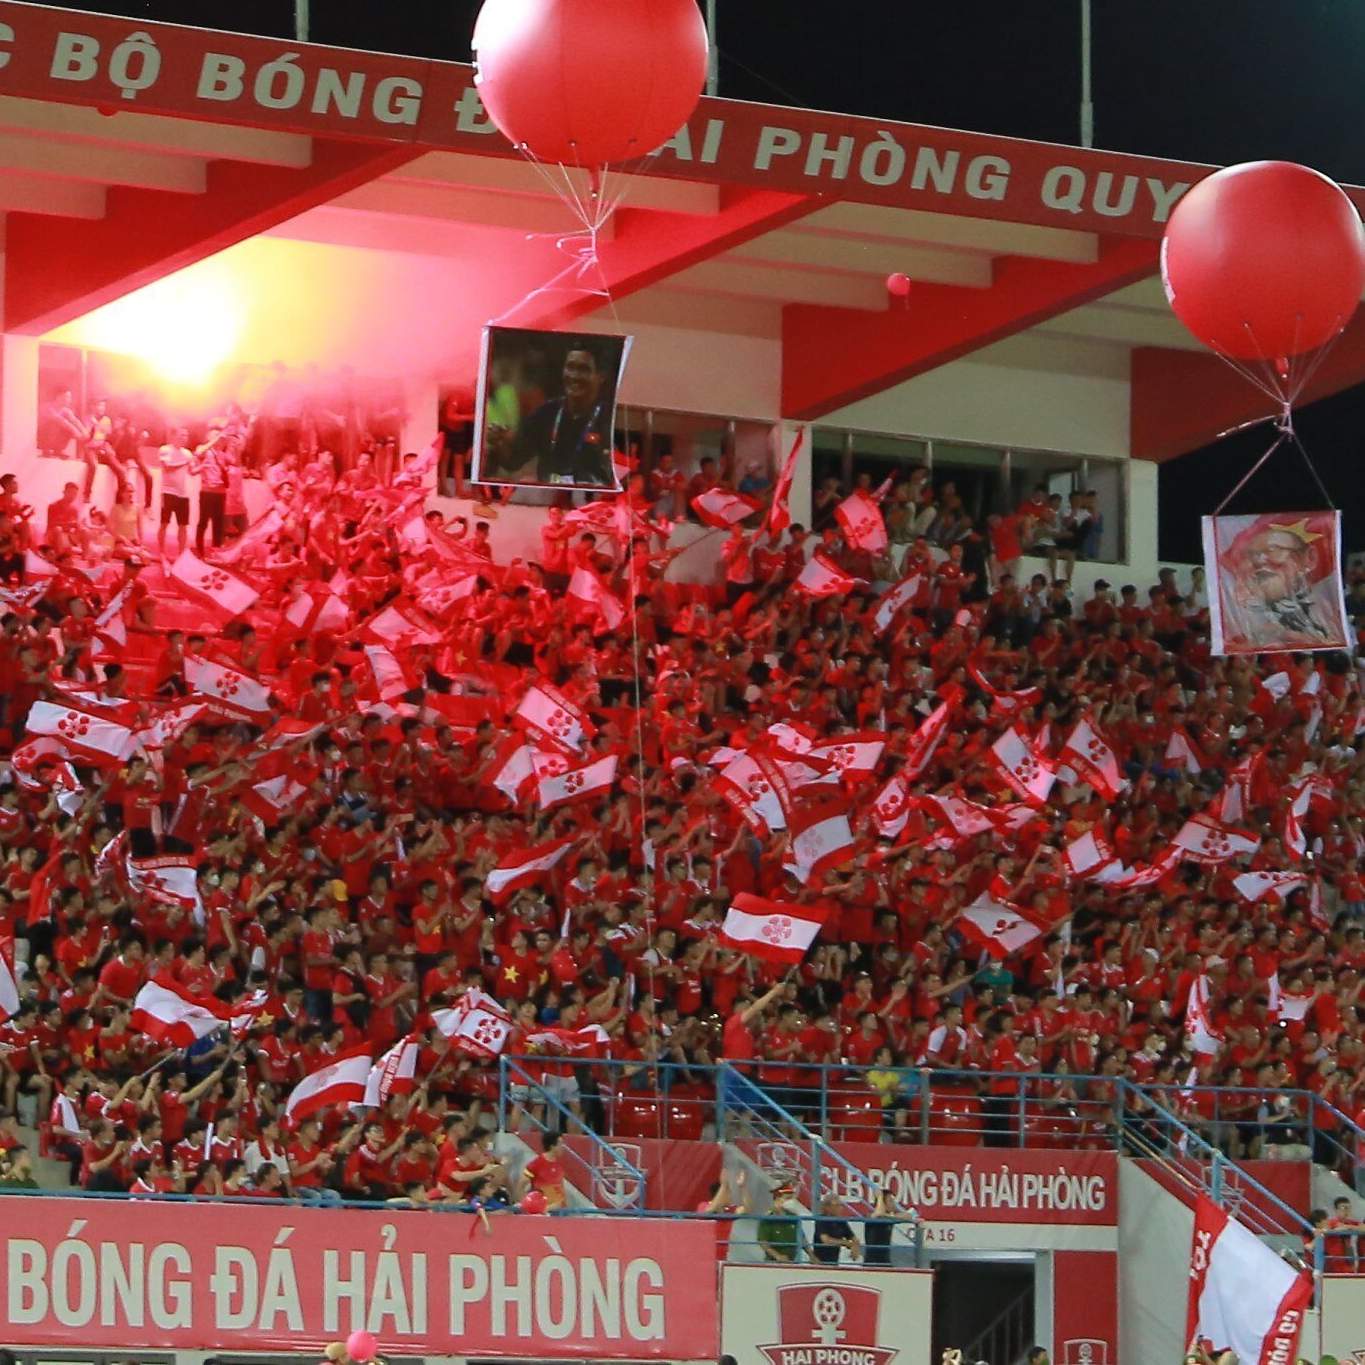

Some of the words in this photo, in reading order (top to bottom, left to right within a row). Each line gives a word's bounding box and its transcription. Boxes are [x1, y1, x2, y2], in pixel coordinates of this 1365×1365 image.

[51, 32, 161, 99] BỘ
[197, 52, 422, 127] BÓNG
[754, 126, 1012, 201] PHÒNG
[868, 1160, 938, 1208] BÓNG
[940, 1163, 977, 1208] ĐÁ
[979, 1164, 1019, 1209] HẢI
[1022, 1166, 1106, 1211] PHÒNG
[939, 1227, 955, 1242] 16
[7, 1219, 193, 1330] BÓNG
[209, 1226, 303, 1332] ĐÁ
[323, 1224, 428, 1336] HẢI
[449, 1235, 665, 1341] PHÒNG
